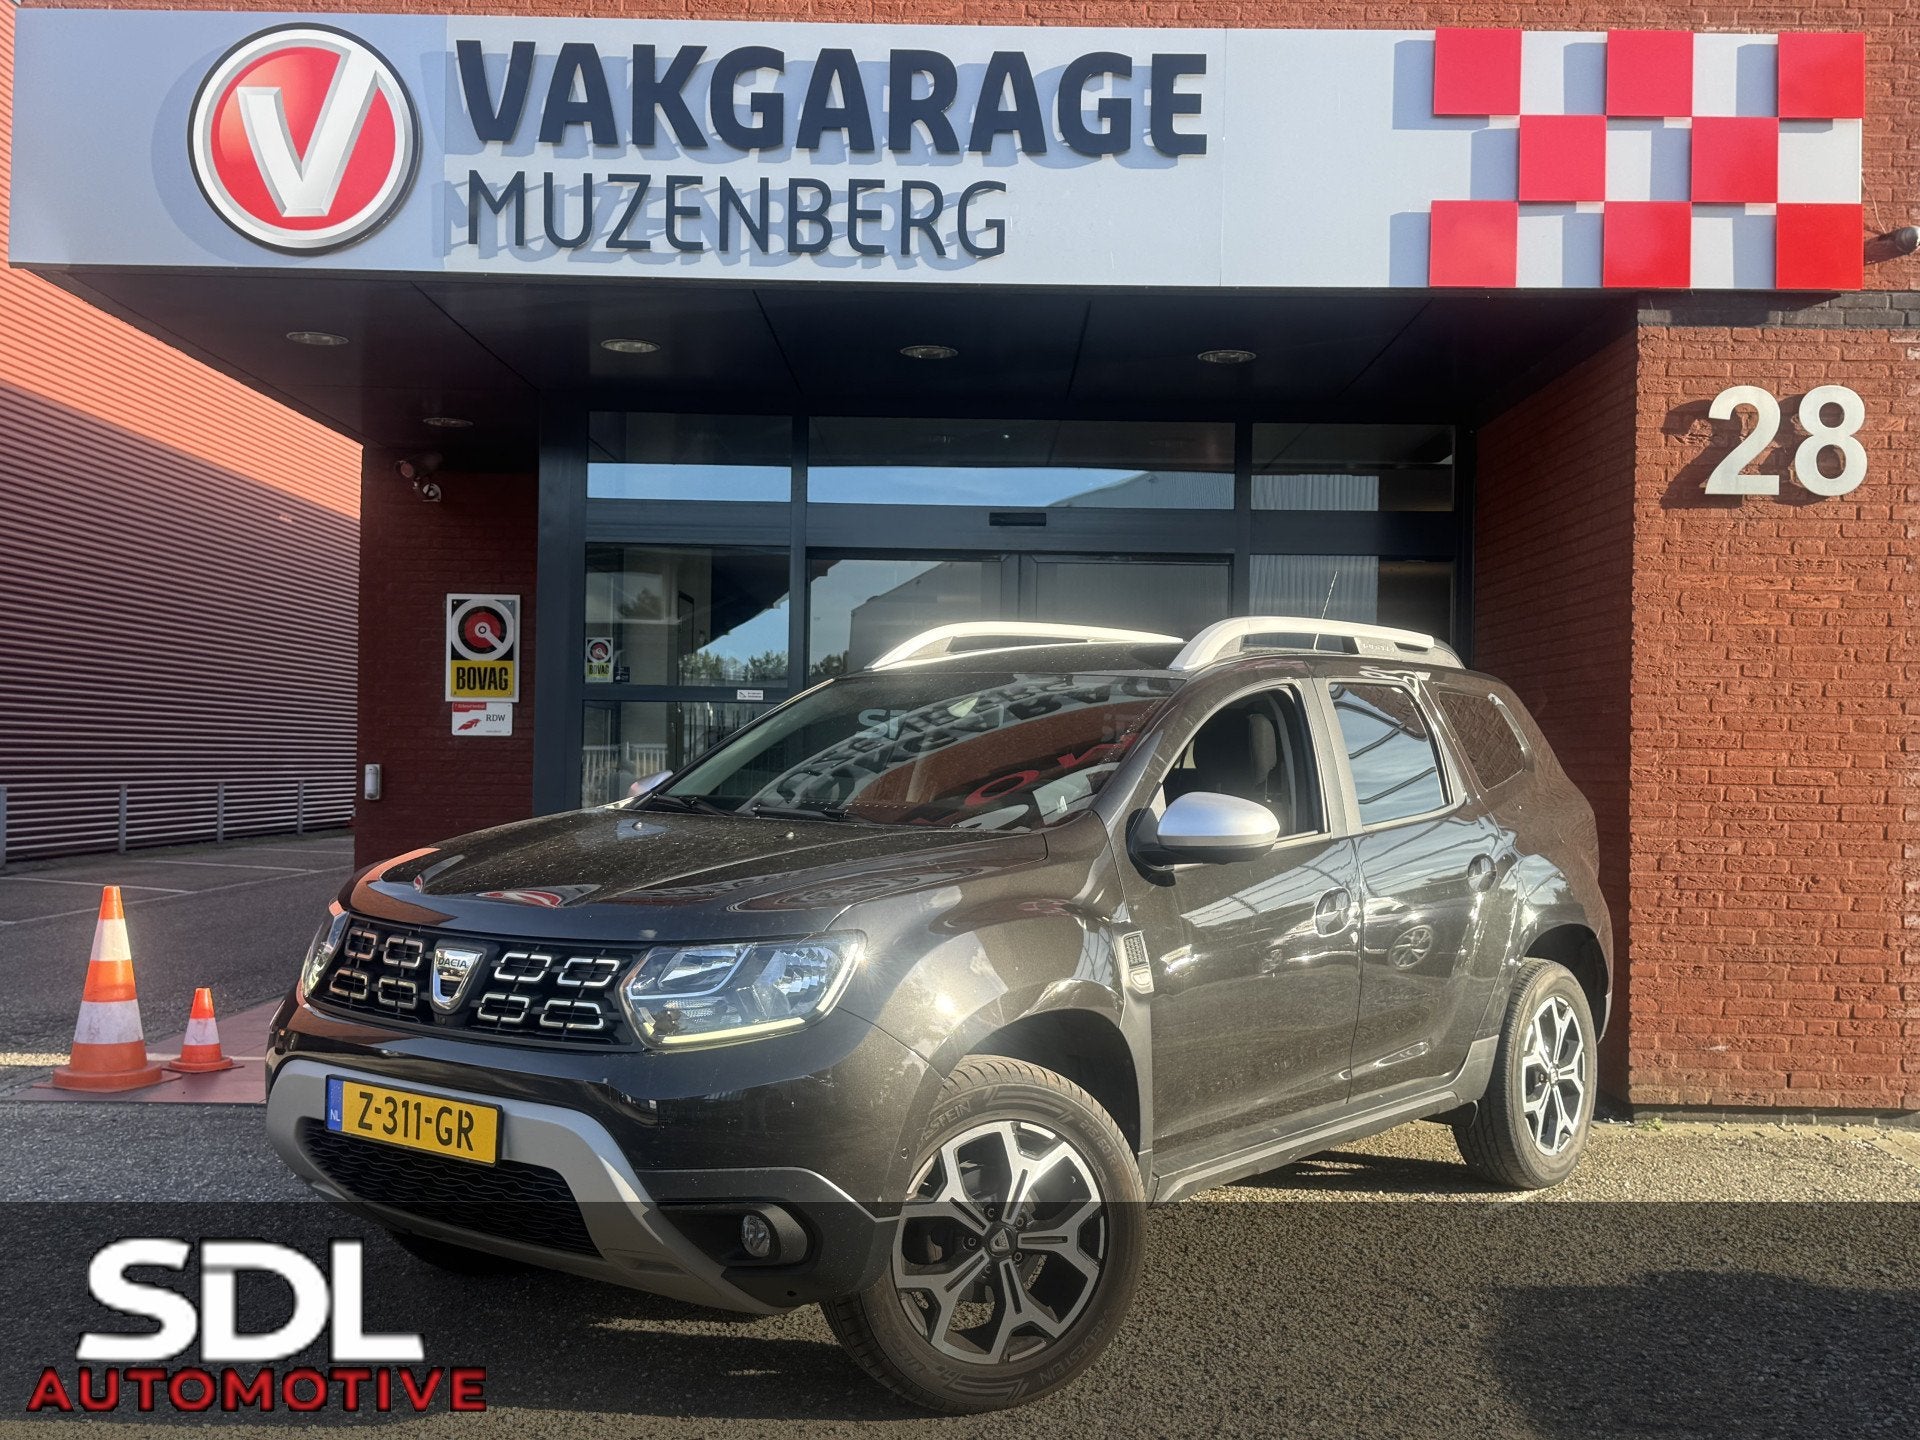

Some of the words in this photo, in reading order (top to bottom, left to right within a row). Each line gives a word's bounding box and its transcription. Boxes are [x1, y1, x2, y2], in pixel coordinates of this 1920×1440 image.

[456, 40, 1208, 156] VAKGARAGE
[468, 169, 1008, 259] MUZENBERG
[1705, 384, 1868, 496] 28
[456, 666, 509, 691] BOVAG
[486, 714, 506, 722] RDW
[437, 957, 467, 969] DACIA
[330, 1108, 341, 1122] NL
[357, 1091, 475, 1152] Z-311-GR
